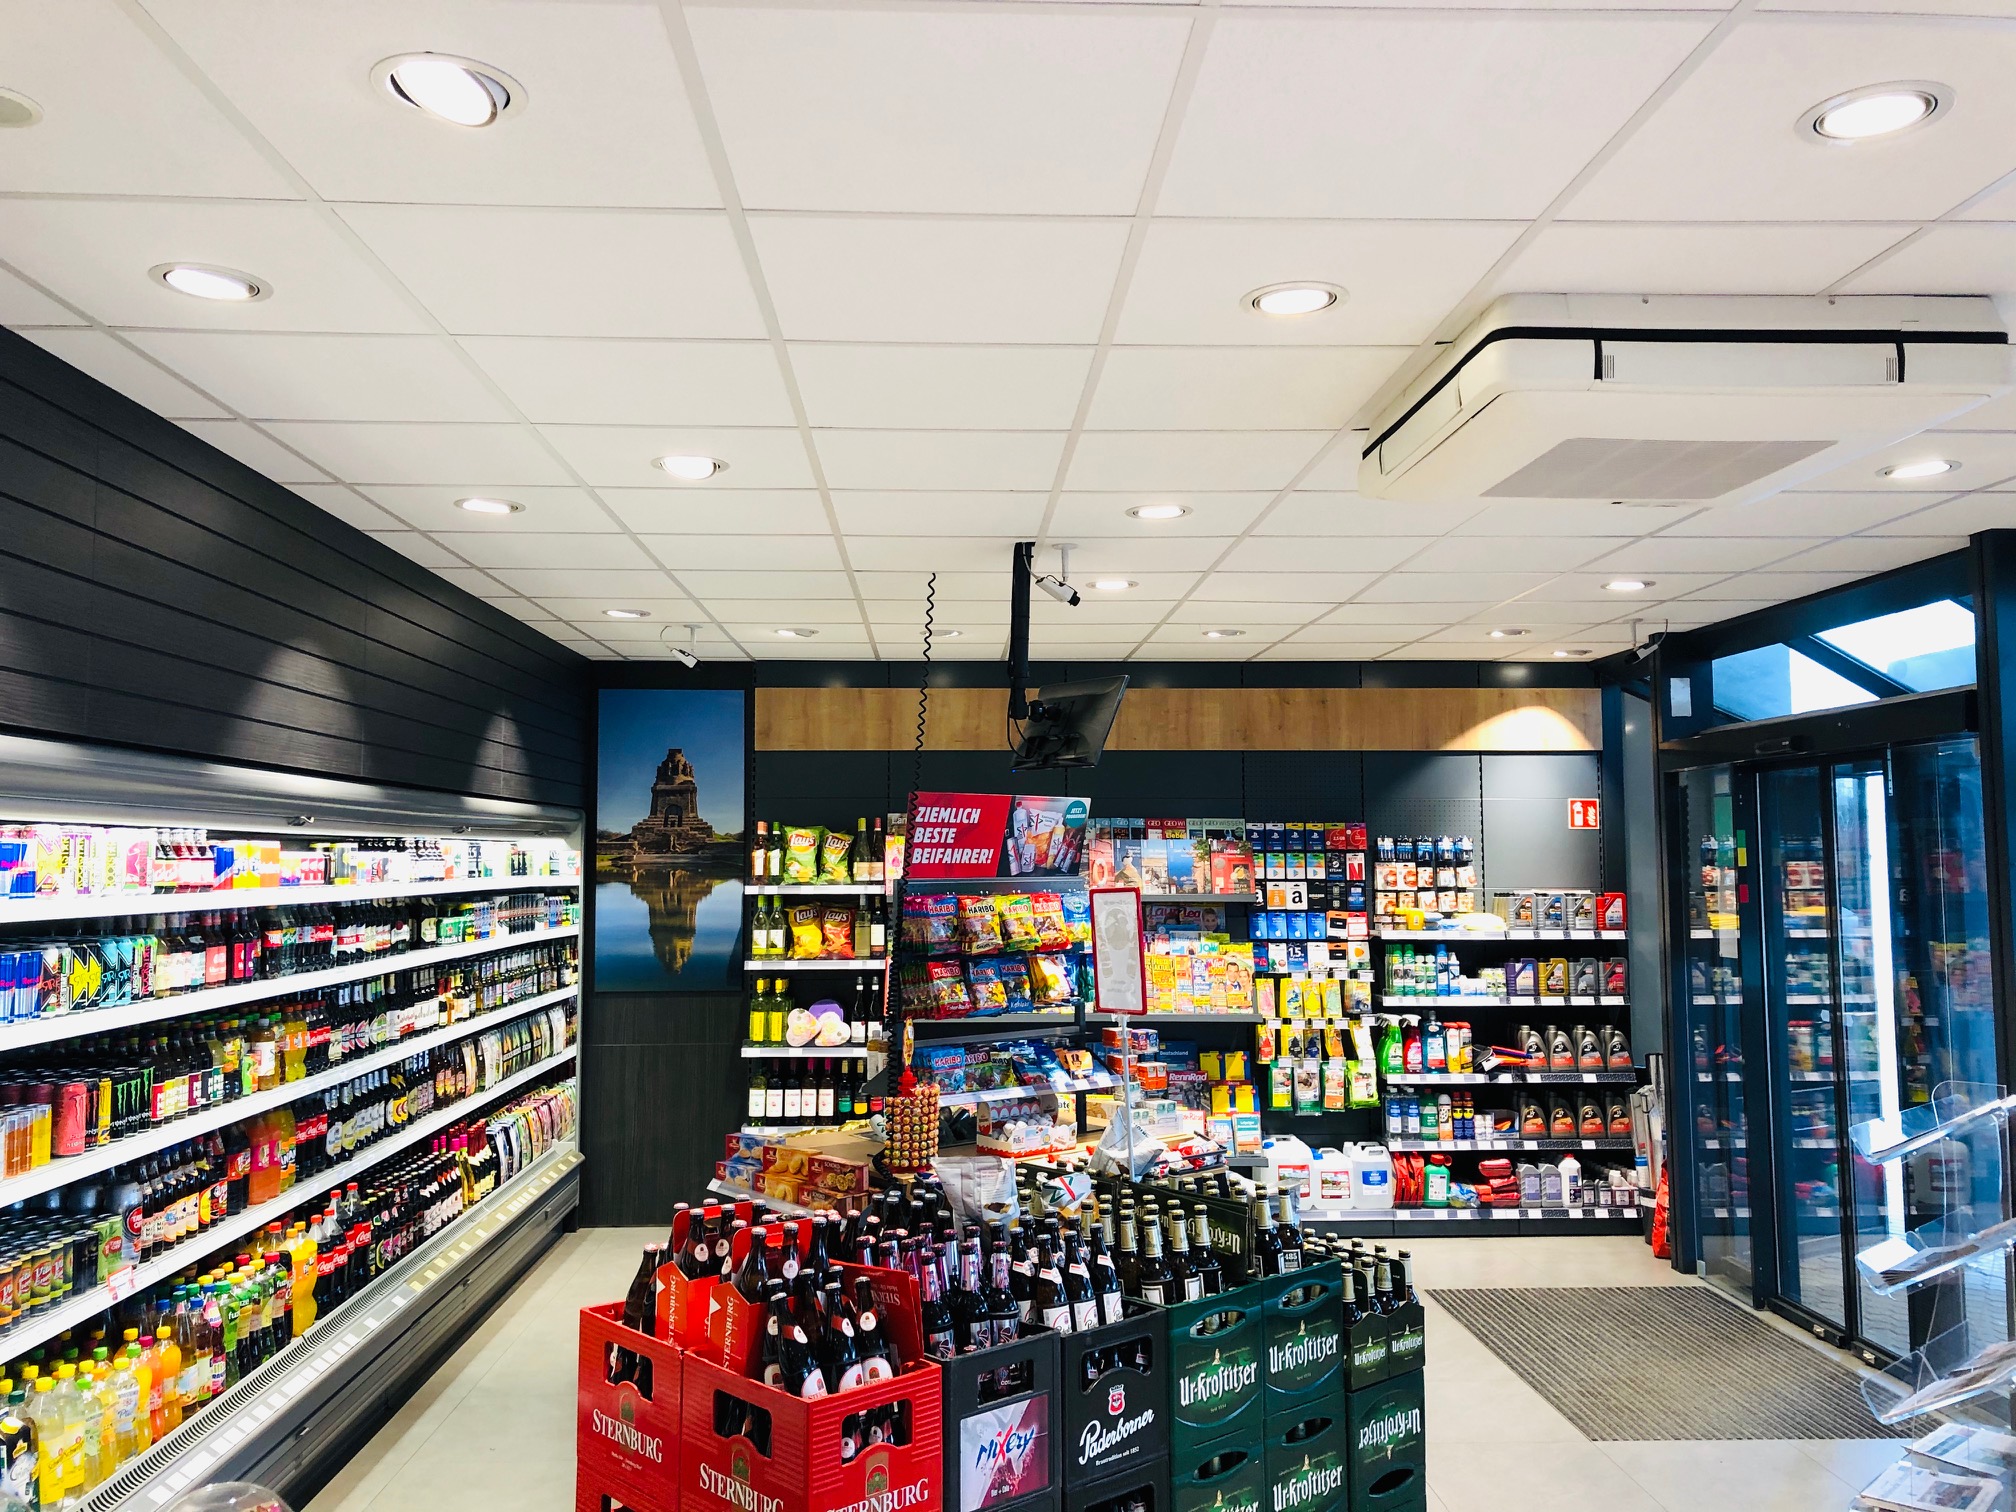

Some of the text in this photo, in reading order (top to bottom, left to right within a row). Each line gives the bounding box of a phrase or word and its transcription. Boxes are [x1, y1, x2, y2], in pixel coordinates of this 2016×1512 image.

[915, 806, 981, 824] ZIEMLICH
[913, 827, 957, 844] BESTE
[912, 848, 994, 864] BEIFAHRER!
[928, 904, 955, 914] HARIBO
[968, 904, 995, 914] HARIBO
[1003, 903, 1029, 914] HARIBO
[1034, 902, 1060, 912] HARIBO
[932, 967, 960, 978] HARIBO
[1001, 963, 1027, 973] HARIBO
[934, 1056, 962, 1067] HARIBO
[1168, 1072, 1208, 1082] RennRad
[1284, 1252, 1297, 1260] 485
[723, 1296, 738, 1369] STERNBURG
[592, 1408, 663, 1463] STERNBURG
[1078, 1408, 1155, 1465] Paderborner
